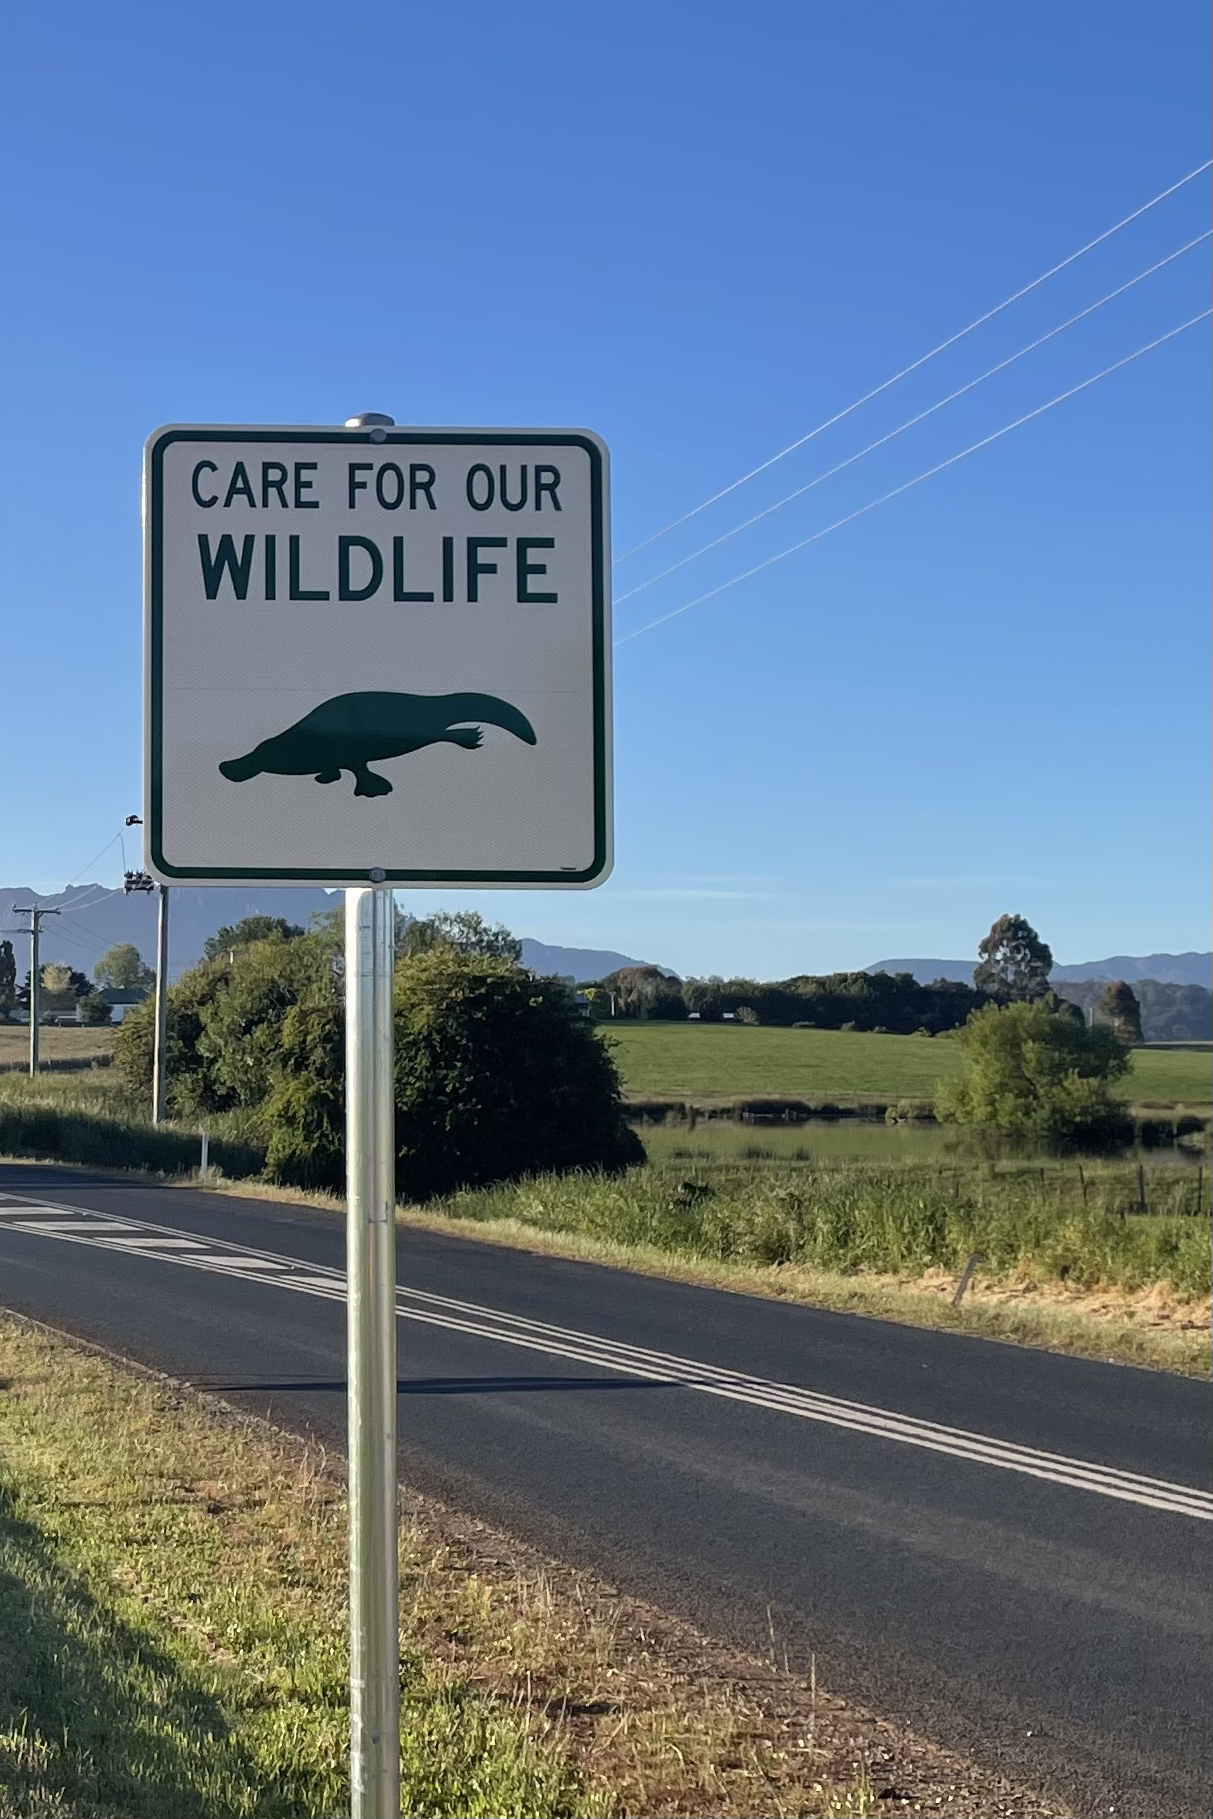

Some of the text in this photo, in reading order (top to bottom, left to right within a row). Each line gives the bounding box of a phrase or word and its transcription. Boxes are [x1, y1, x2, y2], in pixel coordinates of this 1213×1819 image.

[191, 459, 562, 512] CARE FOR OUR
[197, 533, 559, 604] WILDLIFE
